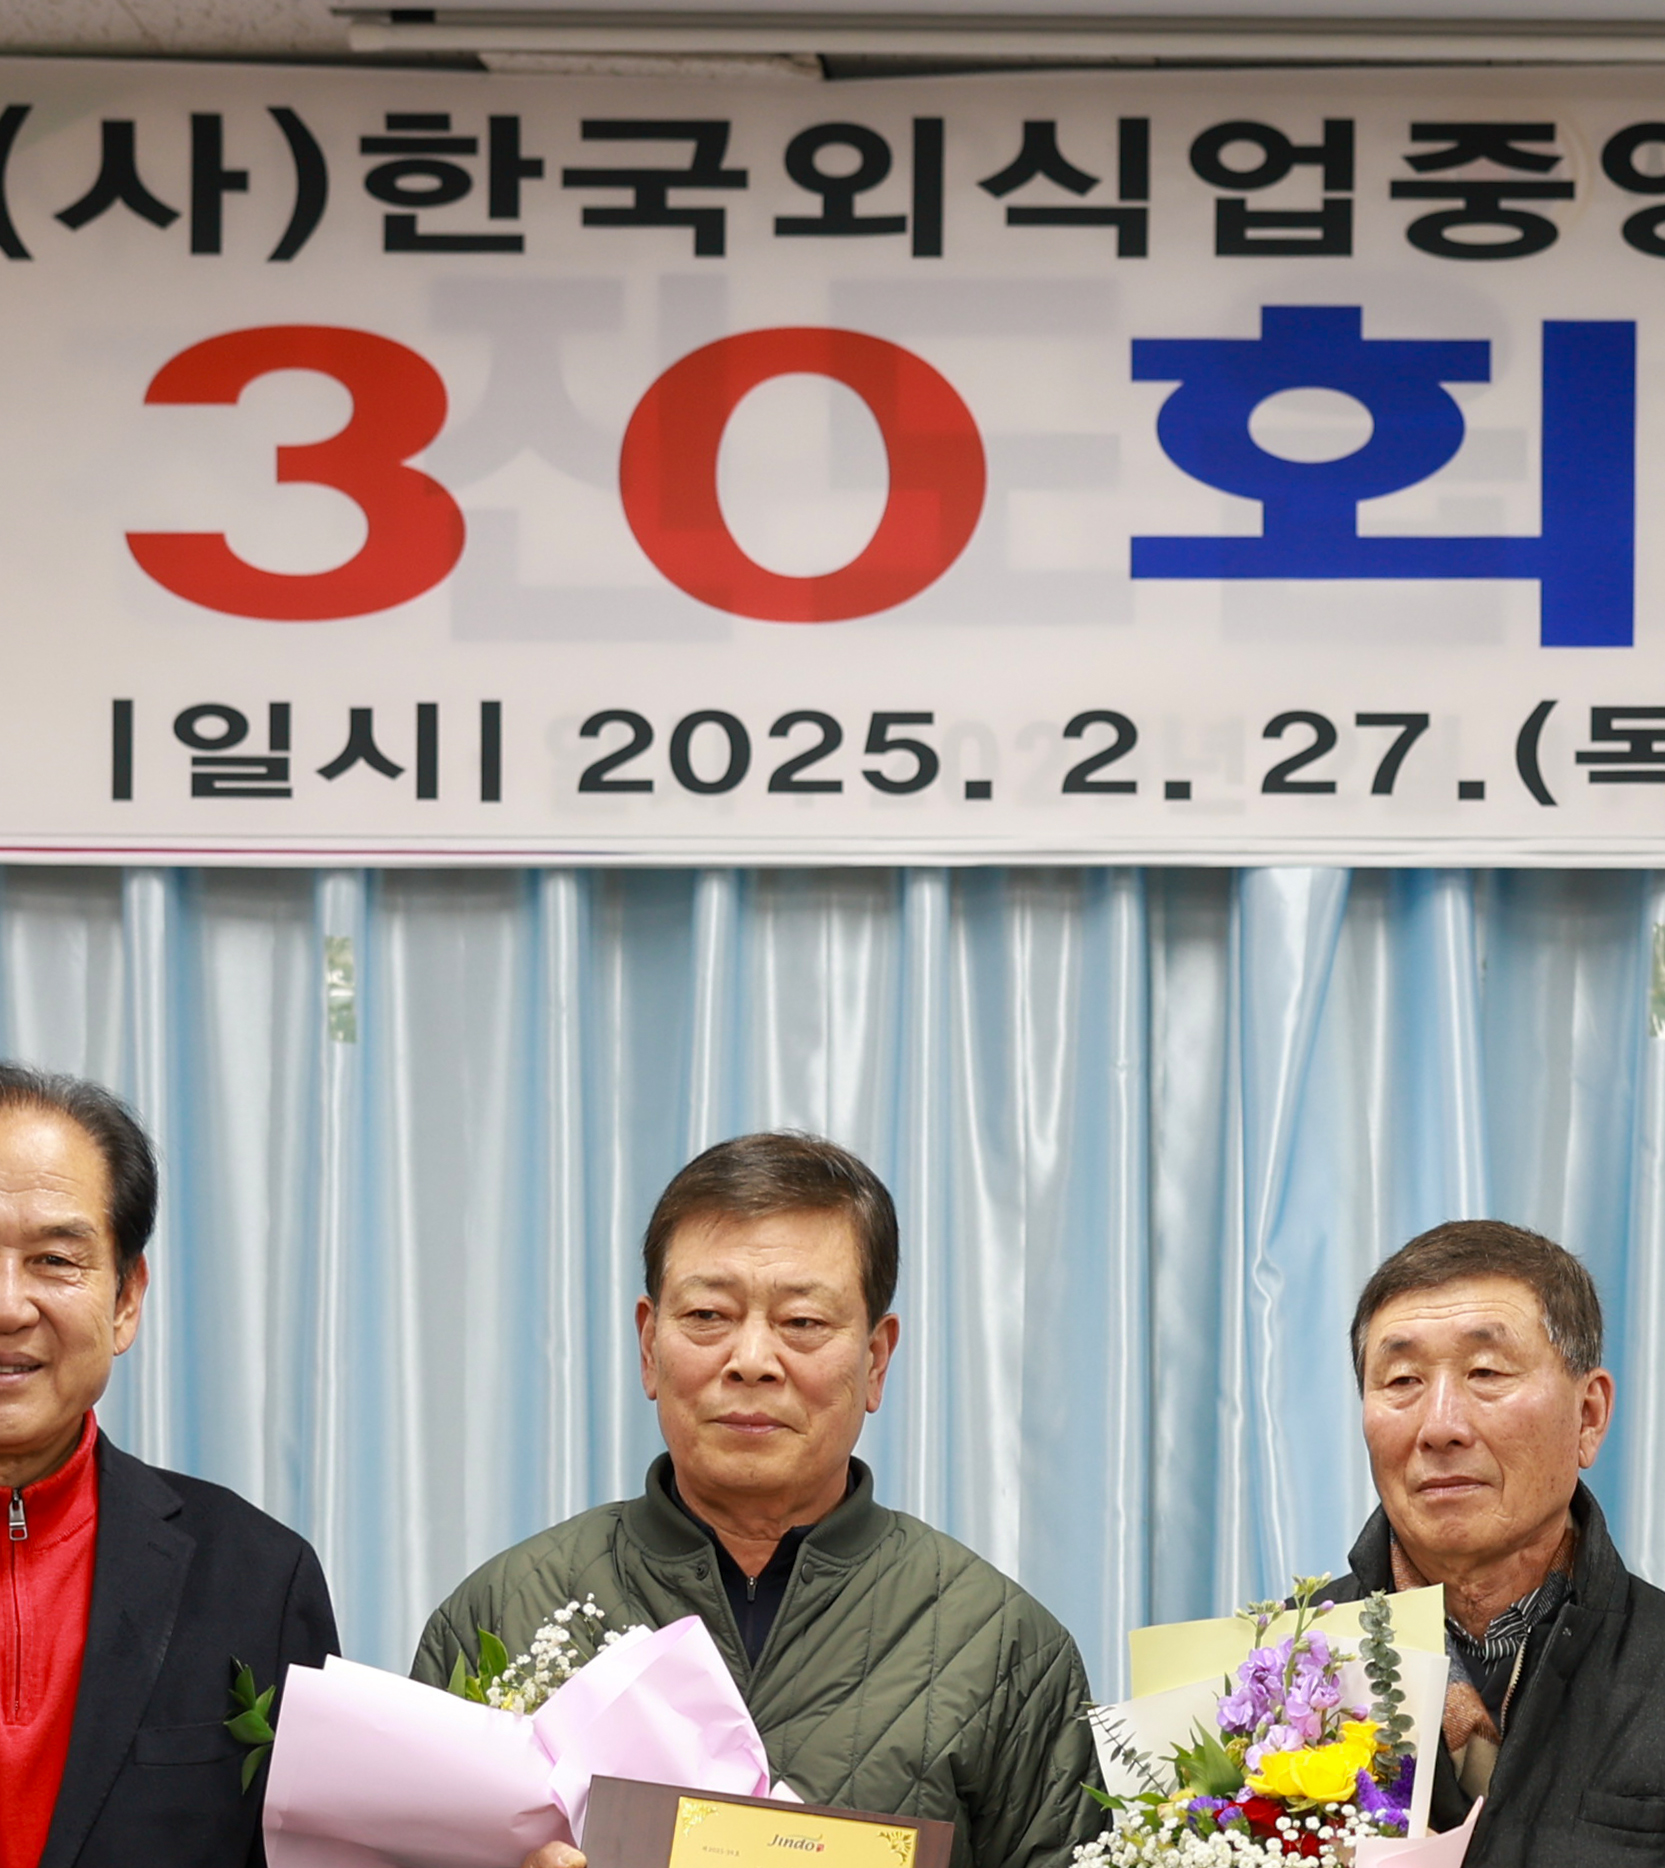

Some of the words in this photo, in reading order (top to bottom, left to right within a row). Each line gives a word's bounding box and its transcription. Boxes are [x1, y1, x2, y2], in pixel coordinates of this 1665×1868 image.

[578, 708, 992, 801] 2025.
[1061, 708, 1192, 801] 2.
[767, 1833, 818, 1853] Jindo
